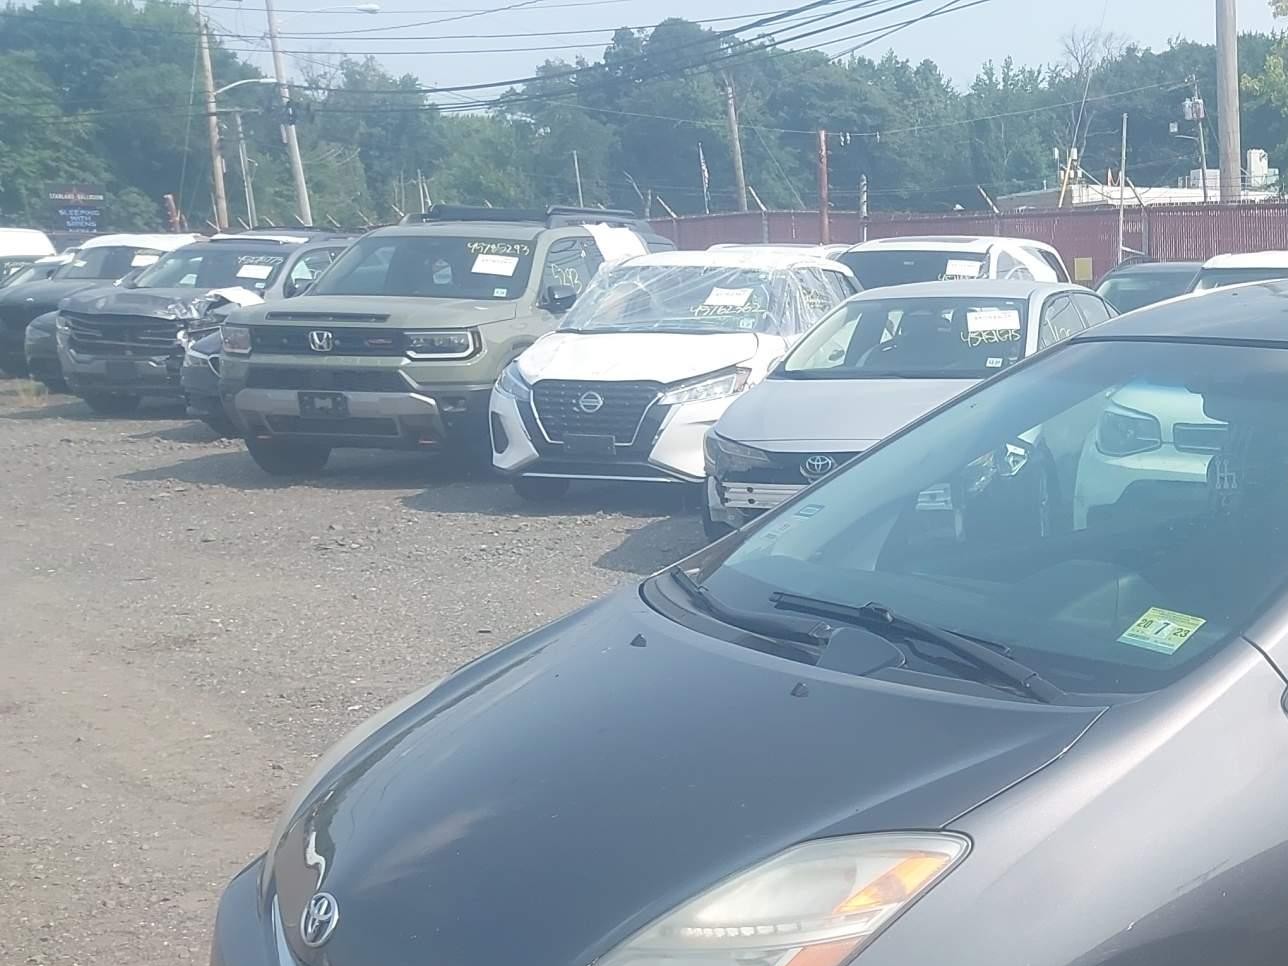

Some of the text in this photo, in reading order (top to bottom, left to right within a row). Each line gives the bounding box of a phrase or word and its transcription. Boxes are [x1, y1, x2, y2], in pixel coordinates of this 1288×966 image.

[467, 241, 530, 256] 45785293
[1136, 618, 1154, 629] 20
[1154, 621, 1170, 635] 7
[1172, 627, 1191, 638] 23
